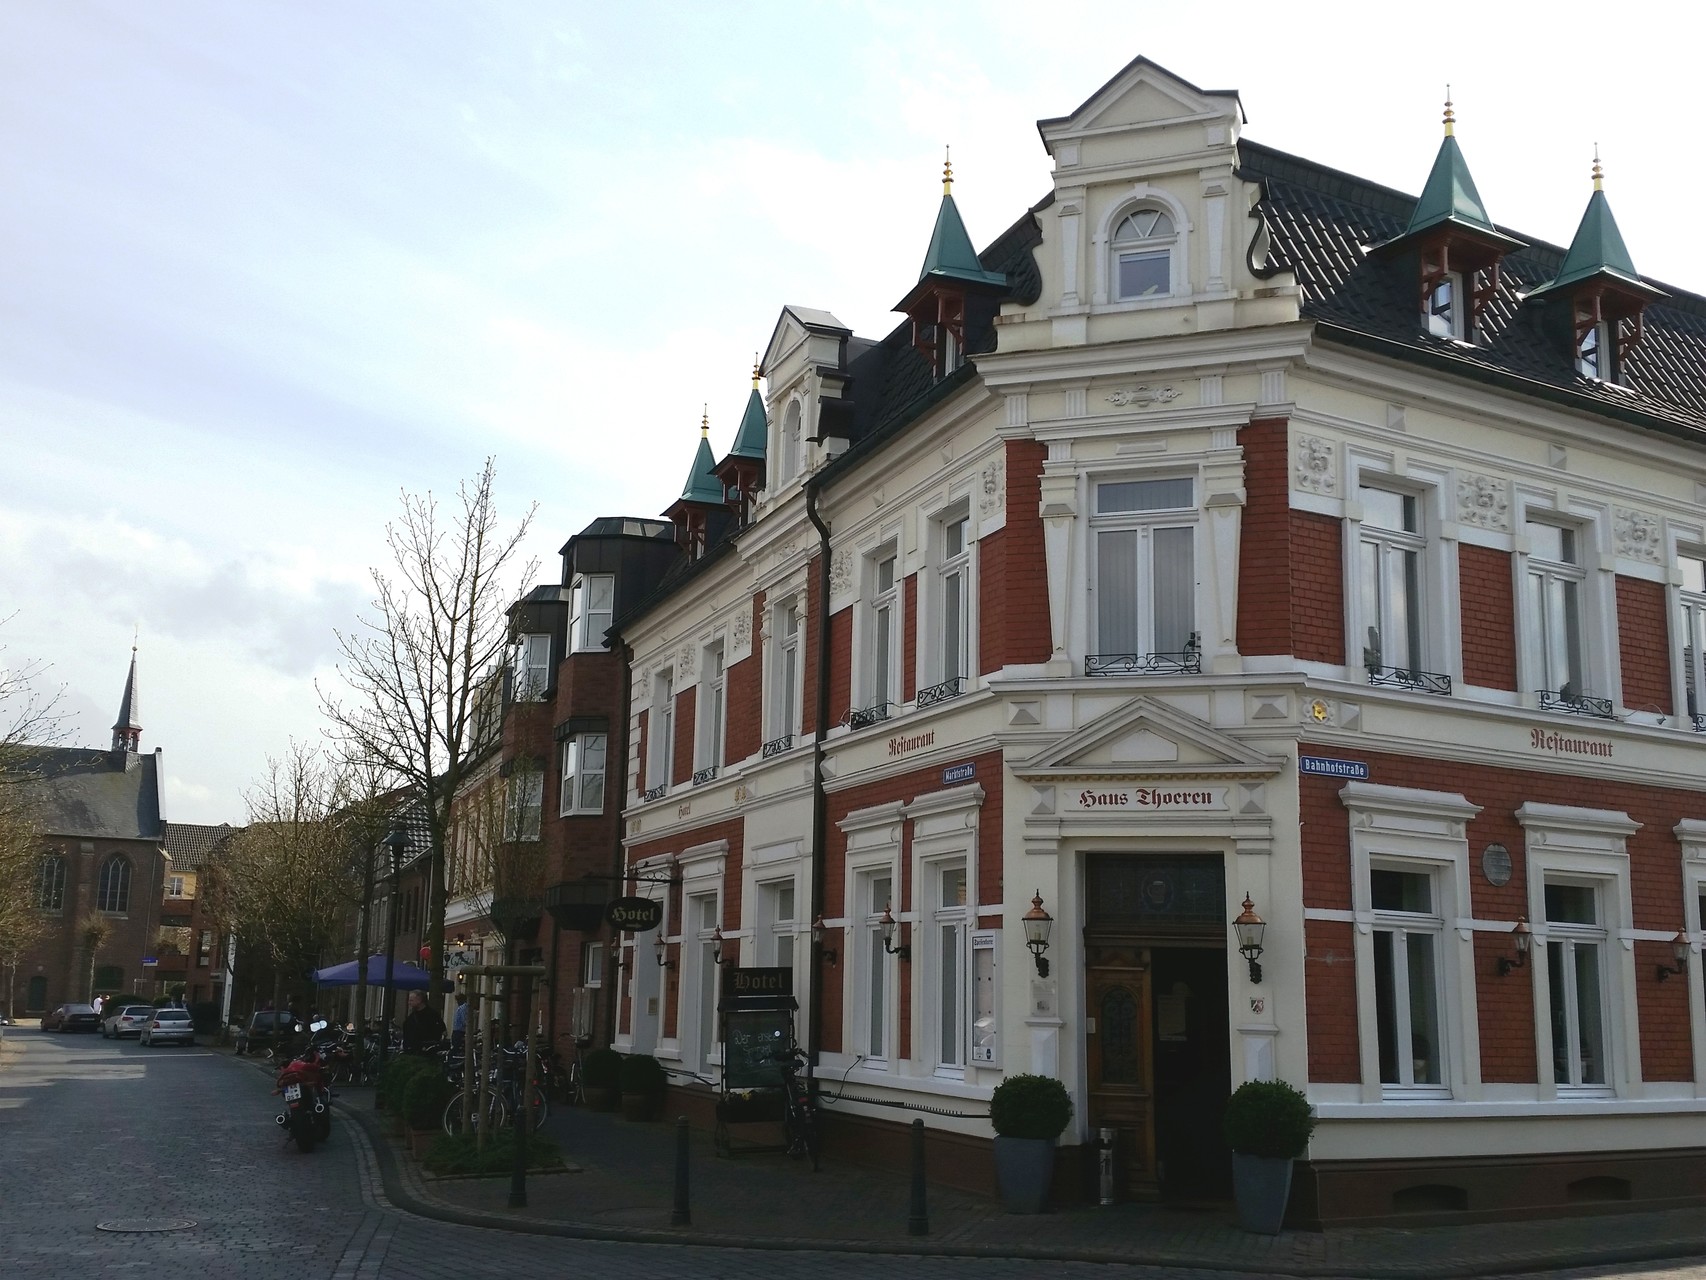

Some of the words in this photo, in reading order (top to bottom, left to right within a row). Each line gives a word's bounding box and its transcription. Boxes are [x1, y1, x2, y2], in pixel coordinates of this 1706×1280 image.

[945, 765, 973, 781] Marktstraße
[1305, 759, 1365, 776] Bahnhofstraße
[1079, 789, 1129, 808] Haus
[1136, 788, 1212, 809] Thoeren
[612, 906, 655, 921] Hotel
[734, 971, 783, 991] Hotel
